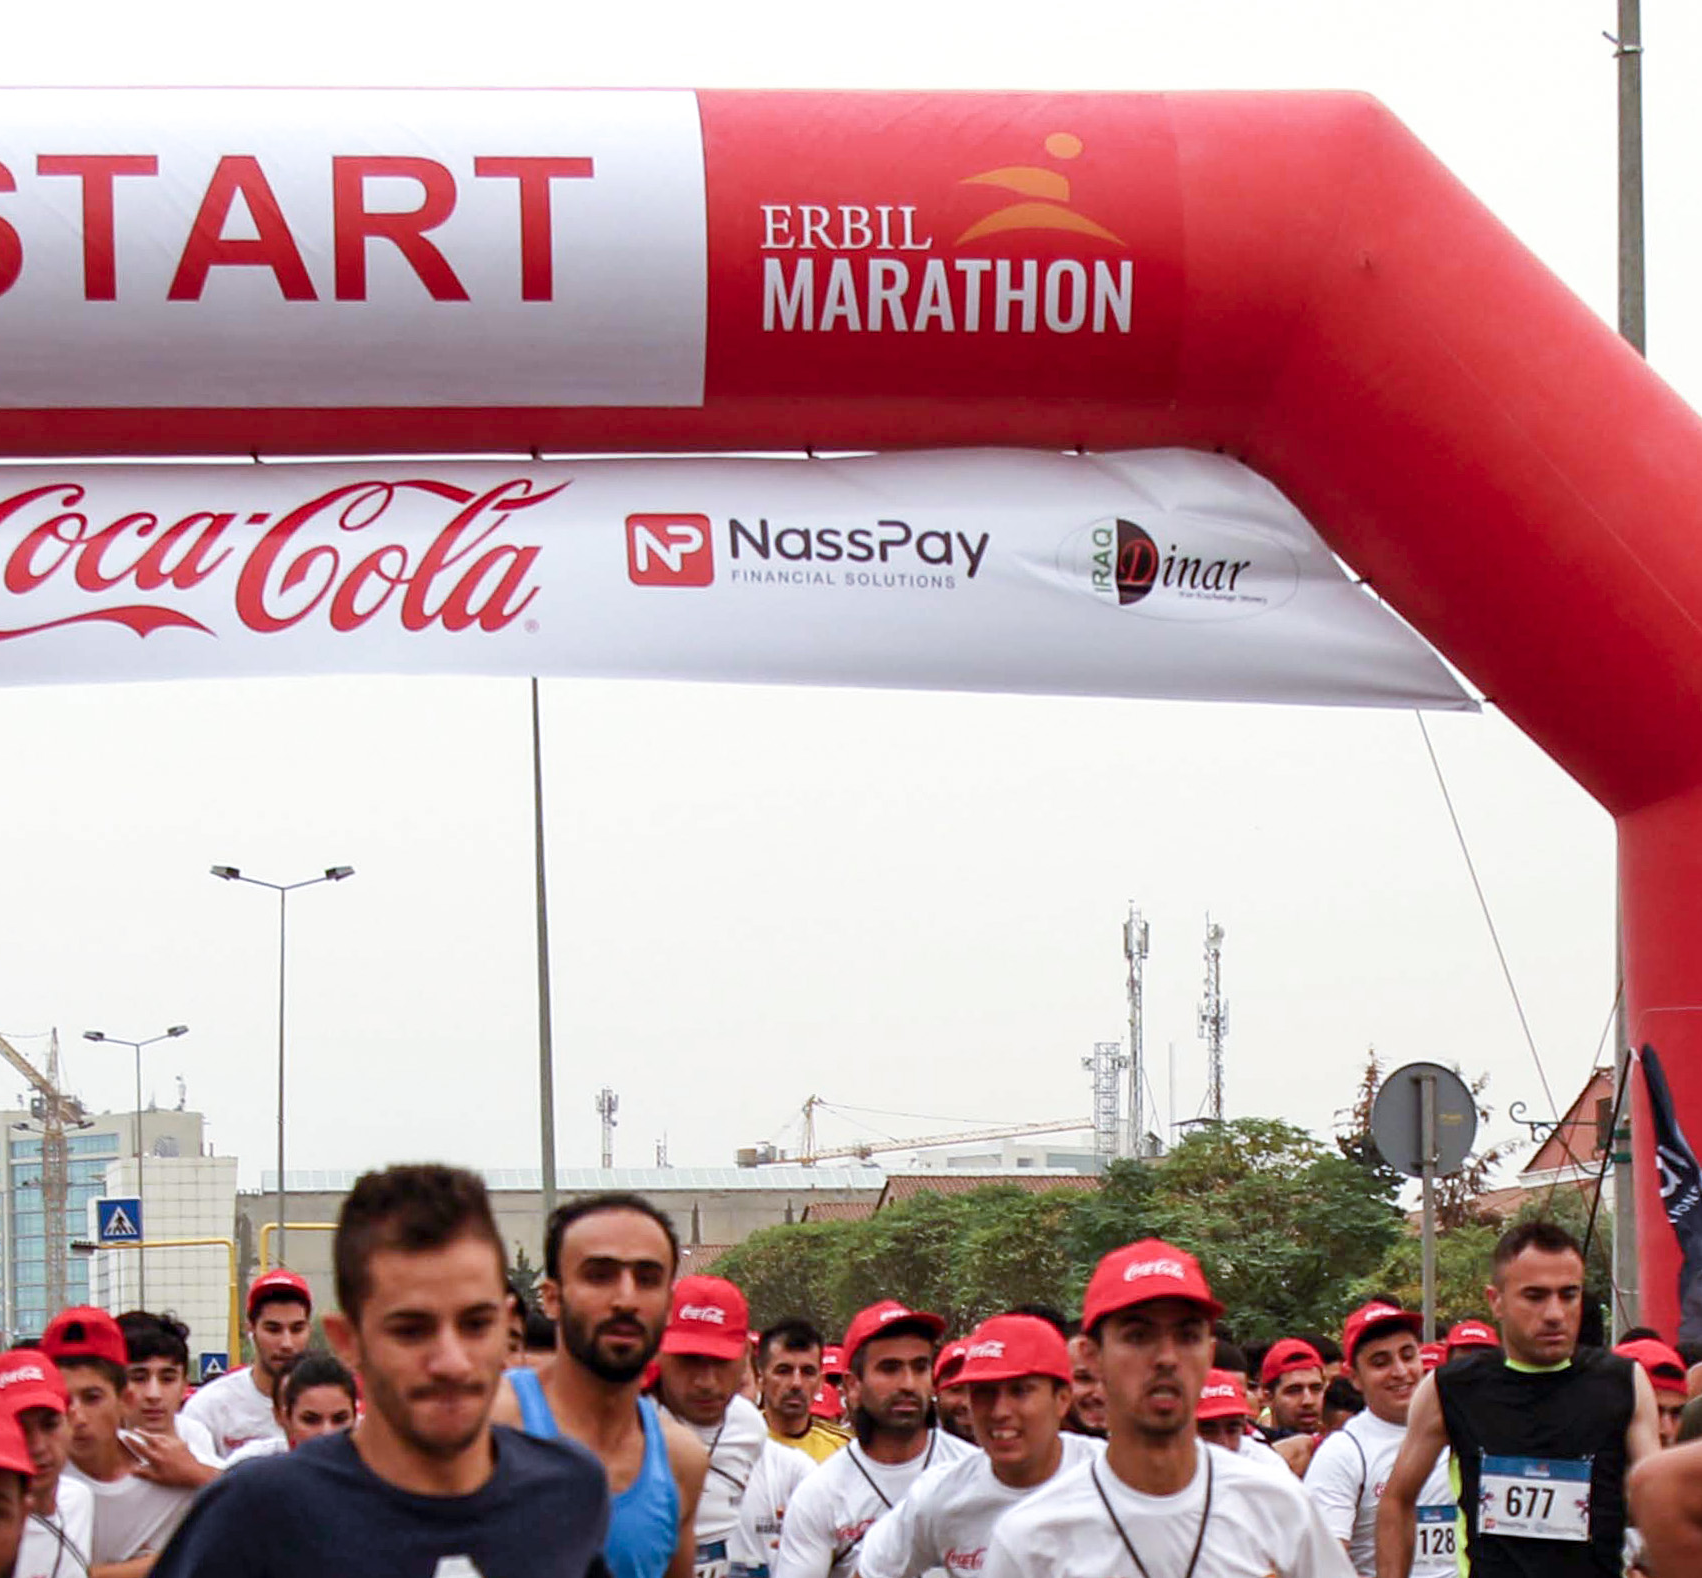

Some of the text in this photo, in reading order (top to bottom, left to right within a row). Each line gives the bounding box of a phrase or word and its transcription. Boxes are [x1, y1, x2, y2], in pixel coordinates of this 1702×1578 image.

[760, 205, 933, 250] ERBIL
[762, 257, 1134, 334] MARATHON
[729, 518, 990, 579] NassPay
[1091, 528, 1114, 593] IRAQ
[731, 570, 956, 590] FINANCIAL SOLUTIONS
[1505, 1485, 1556, 1520] 677
[1419, 1527, 1456, 1554] 128
